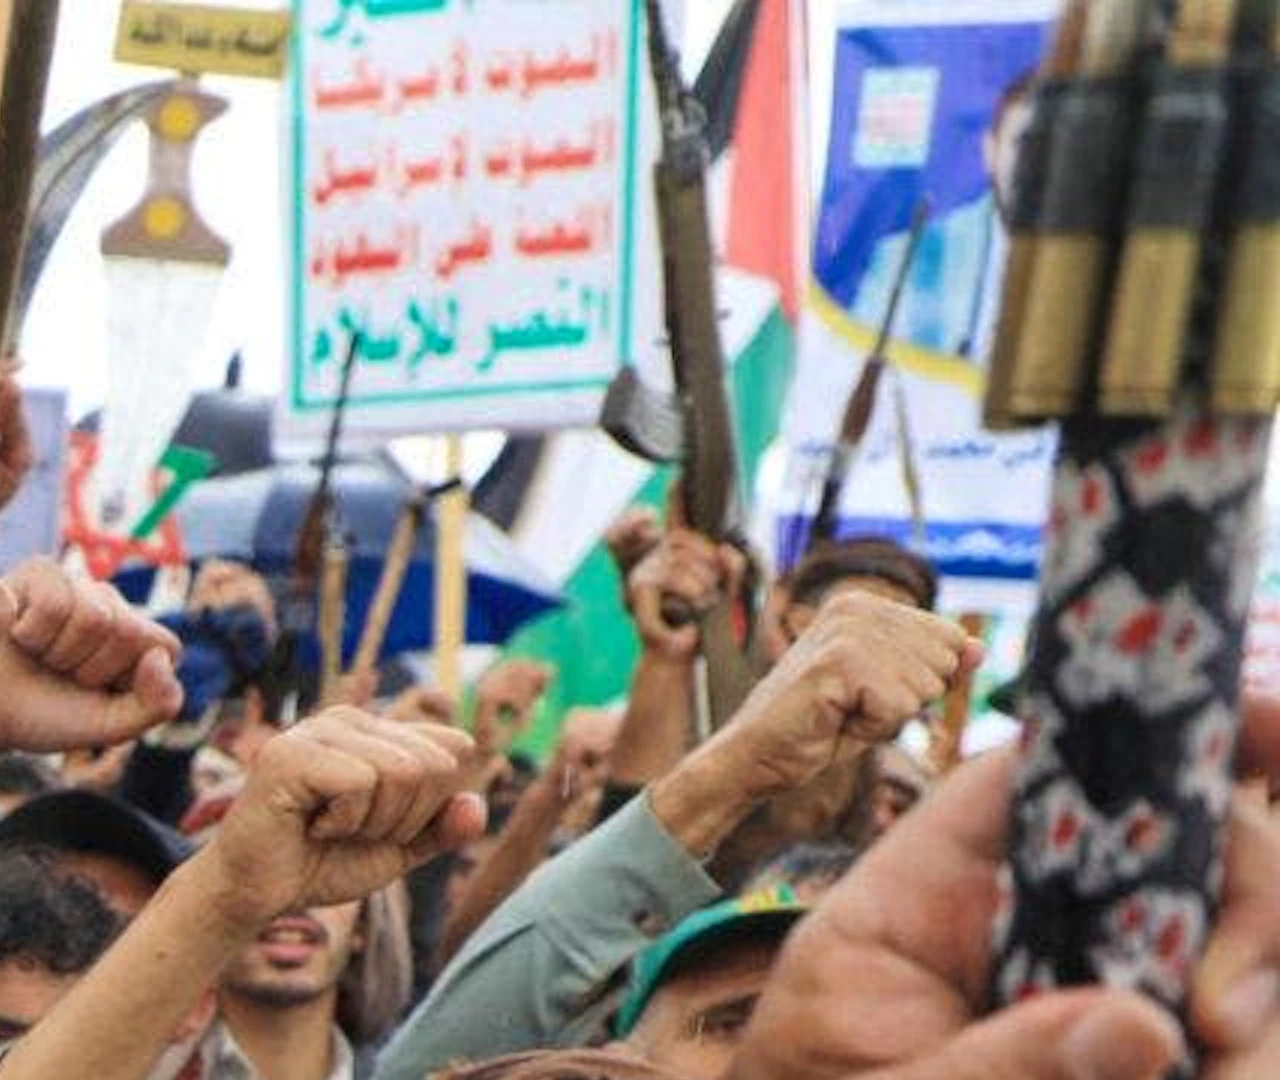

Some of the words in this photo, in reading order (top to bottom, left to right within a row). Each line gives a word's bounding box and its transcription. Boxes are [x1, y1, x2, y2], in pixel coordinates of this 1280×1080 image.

[484, 27, 618, 100] الموت
[484, 115, 618, 188] الموت
[474, 275, 612, 374] النصر
